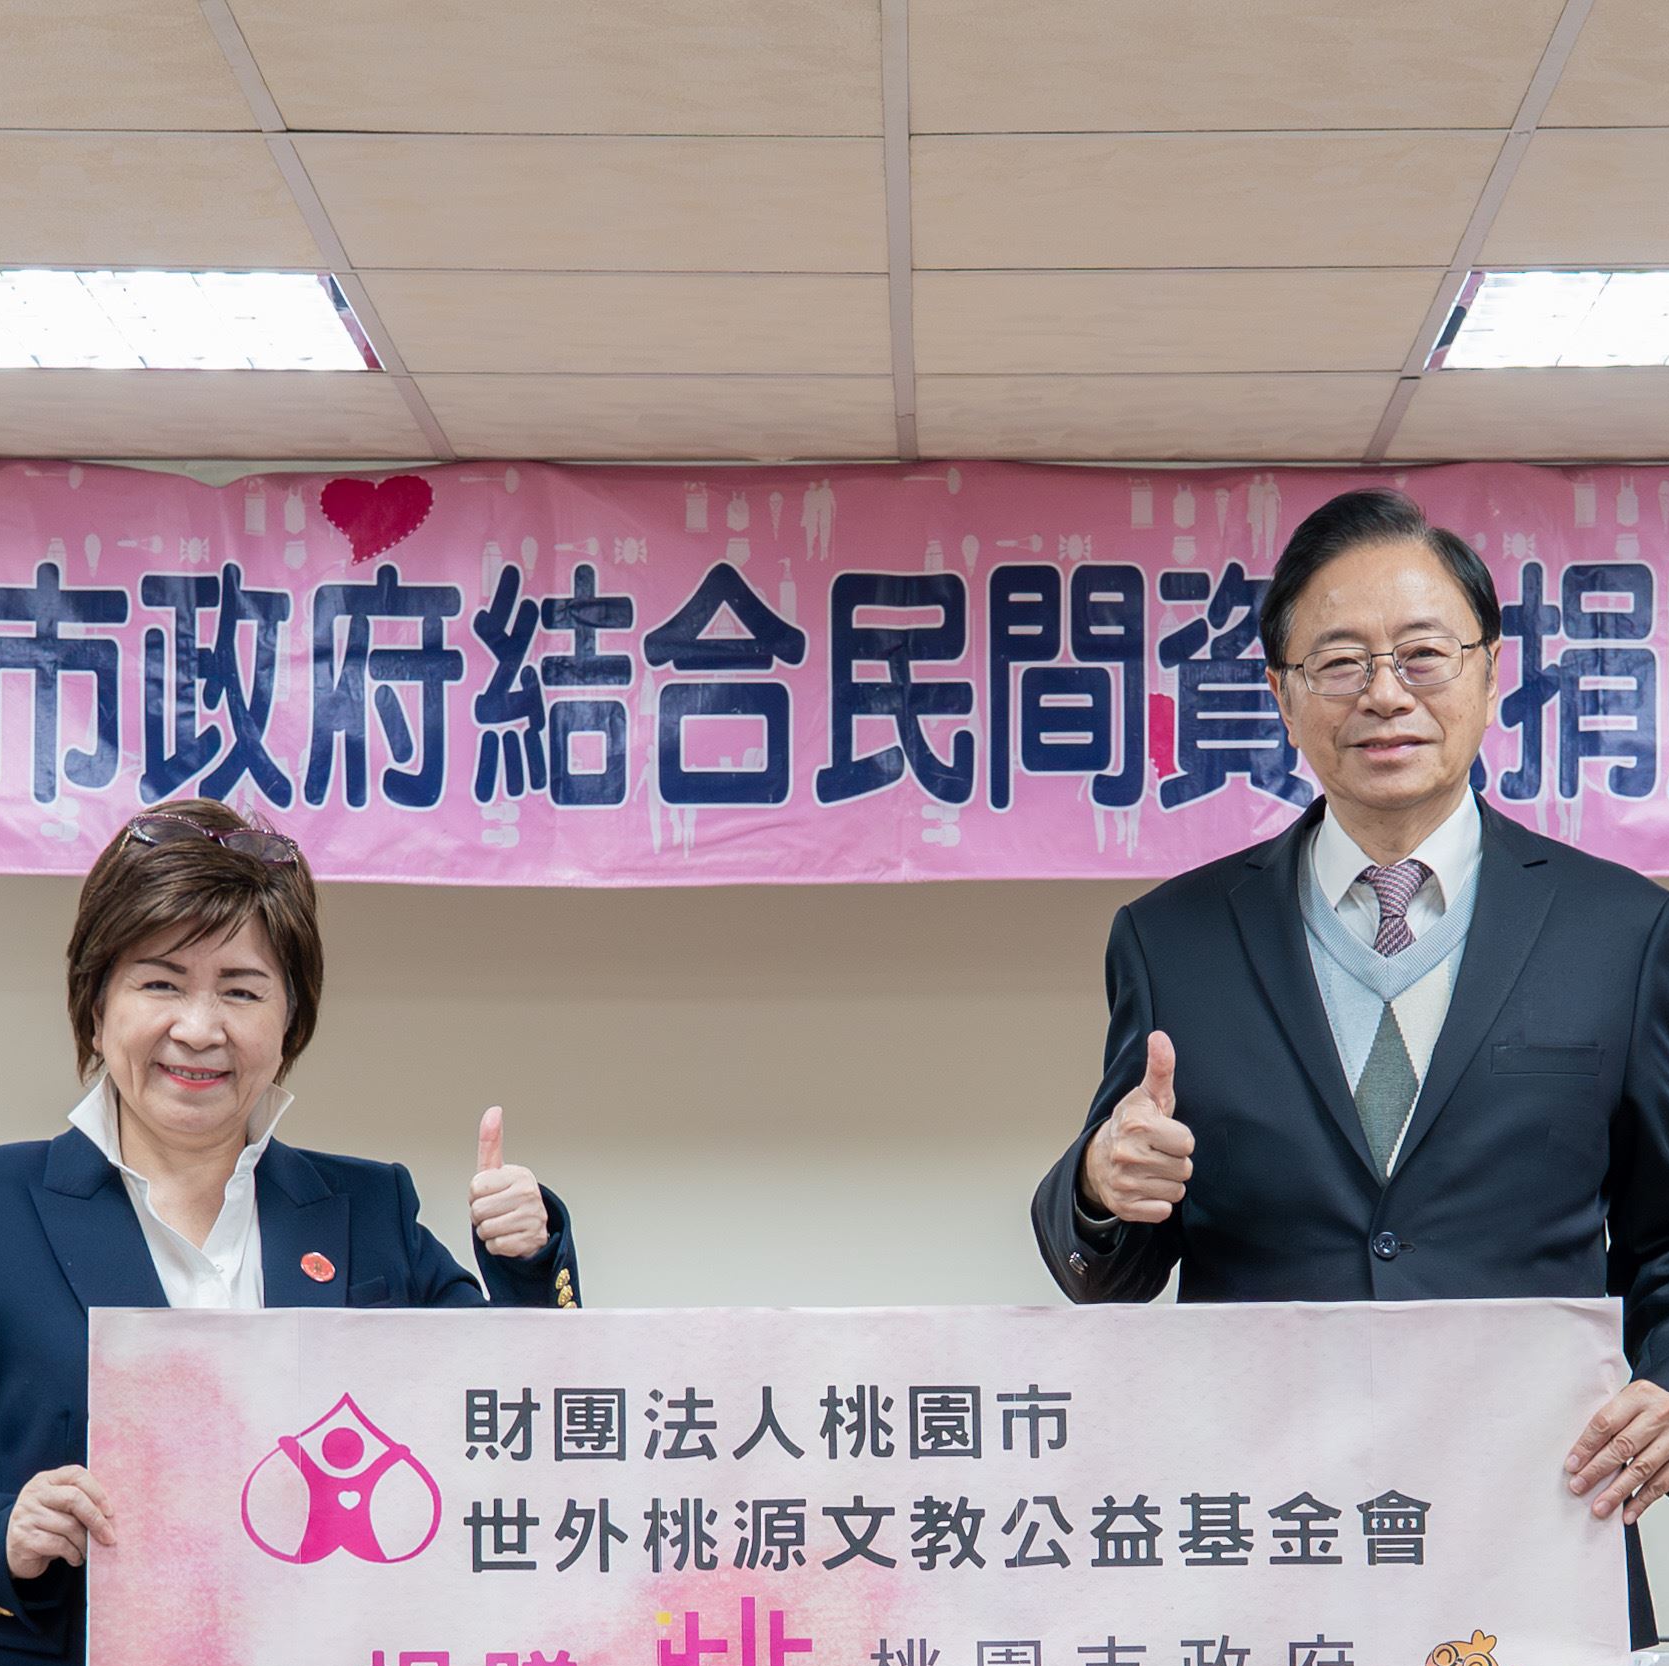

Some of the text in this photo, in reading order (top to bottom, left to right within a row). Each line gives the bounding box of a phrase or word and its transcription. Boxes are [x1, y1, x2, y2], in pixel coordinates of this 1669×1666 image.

[464, 1384, 1073, 1462] 財團法人桃園市
[463, 1489, 1432, 1574] 世外桃源文教公益基金會
